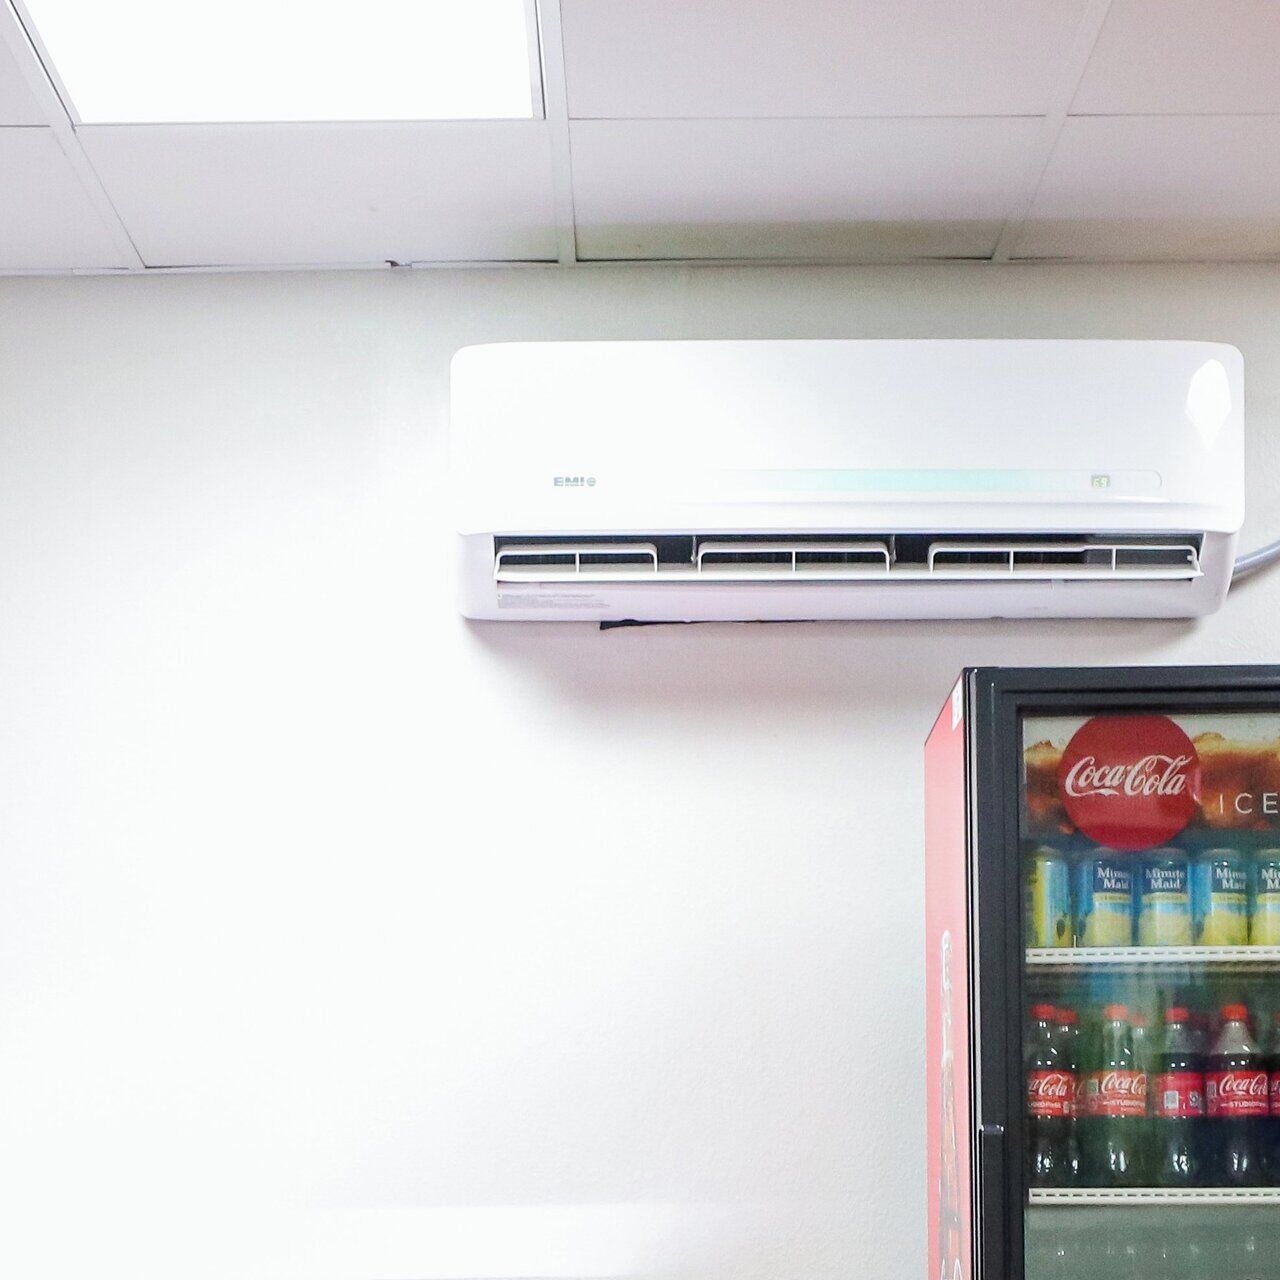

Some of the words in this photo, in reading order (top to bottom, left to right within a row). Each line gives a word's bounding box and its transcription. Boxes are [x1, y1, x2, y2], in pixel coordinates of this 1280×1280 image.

[1064, 754, 1194, 797] Coca-Cola
[1219, 792, 1279, 814] ICE
[1145, 867, 1185, 879] Minute
[1150, 878, 1182, 889] Maid
